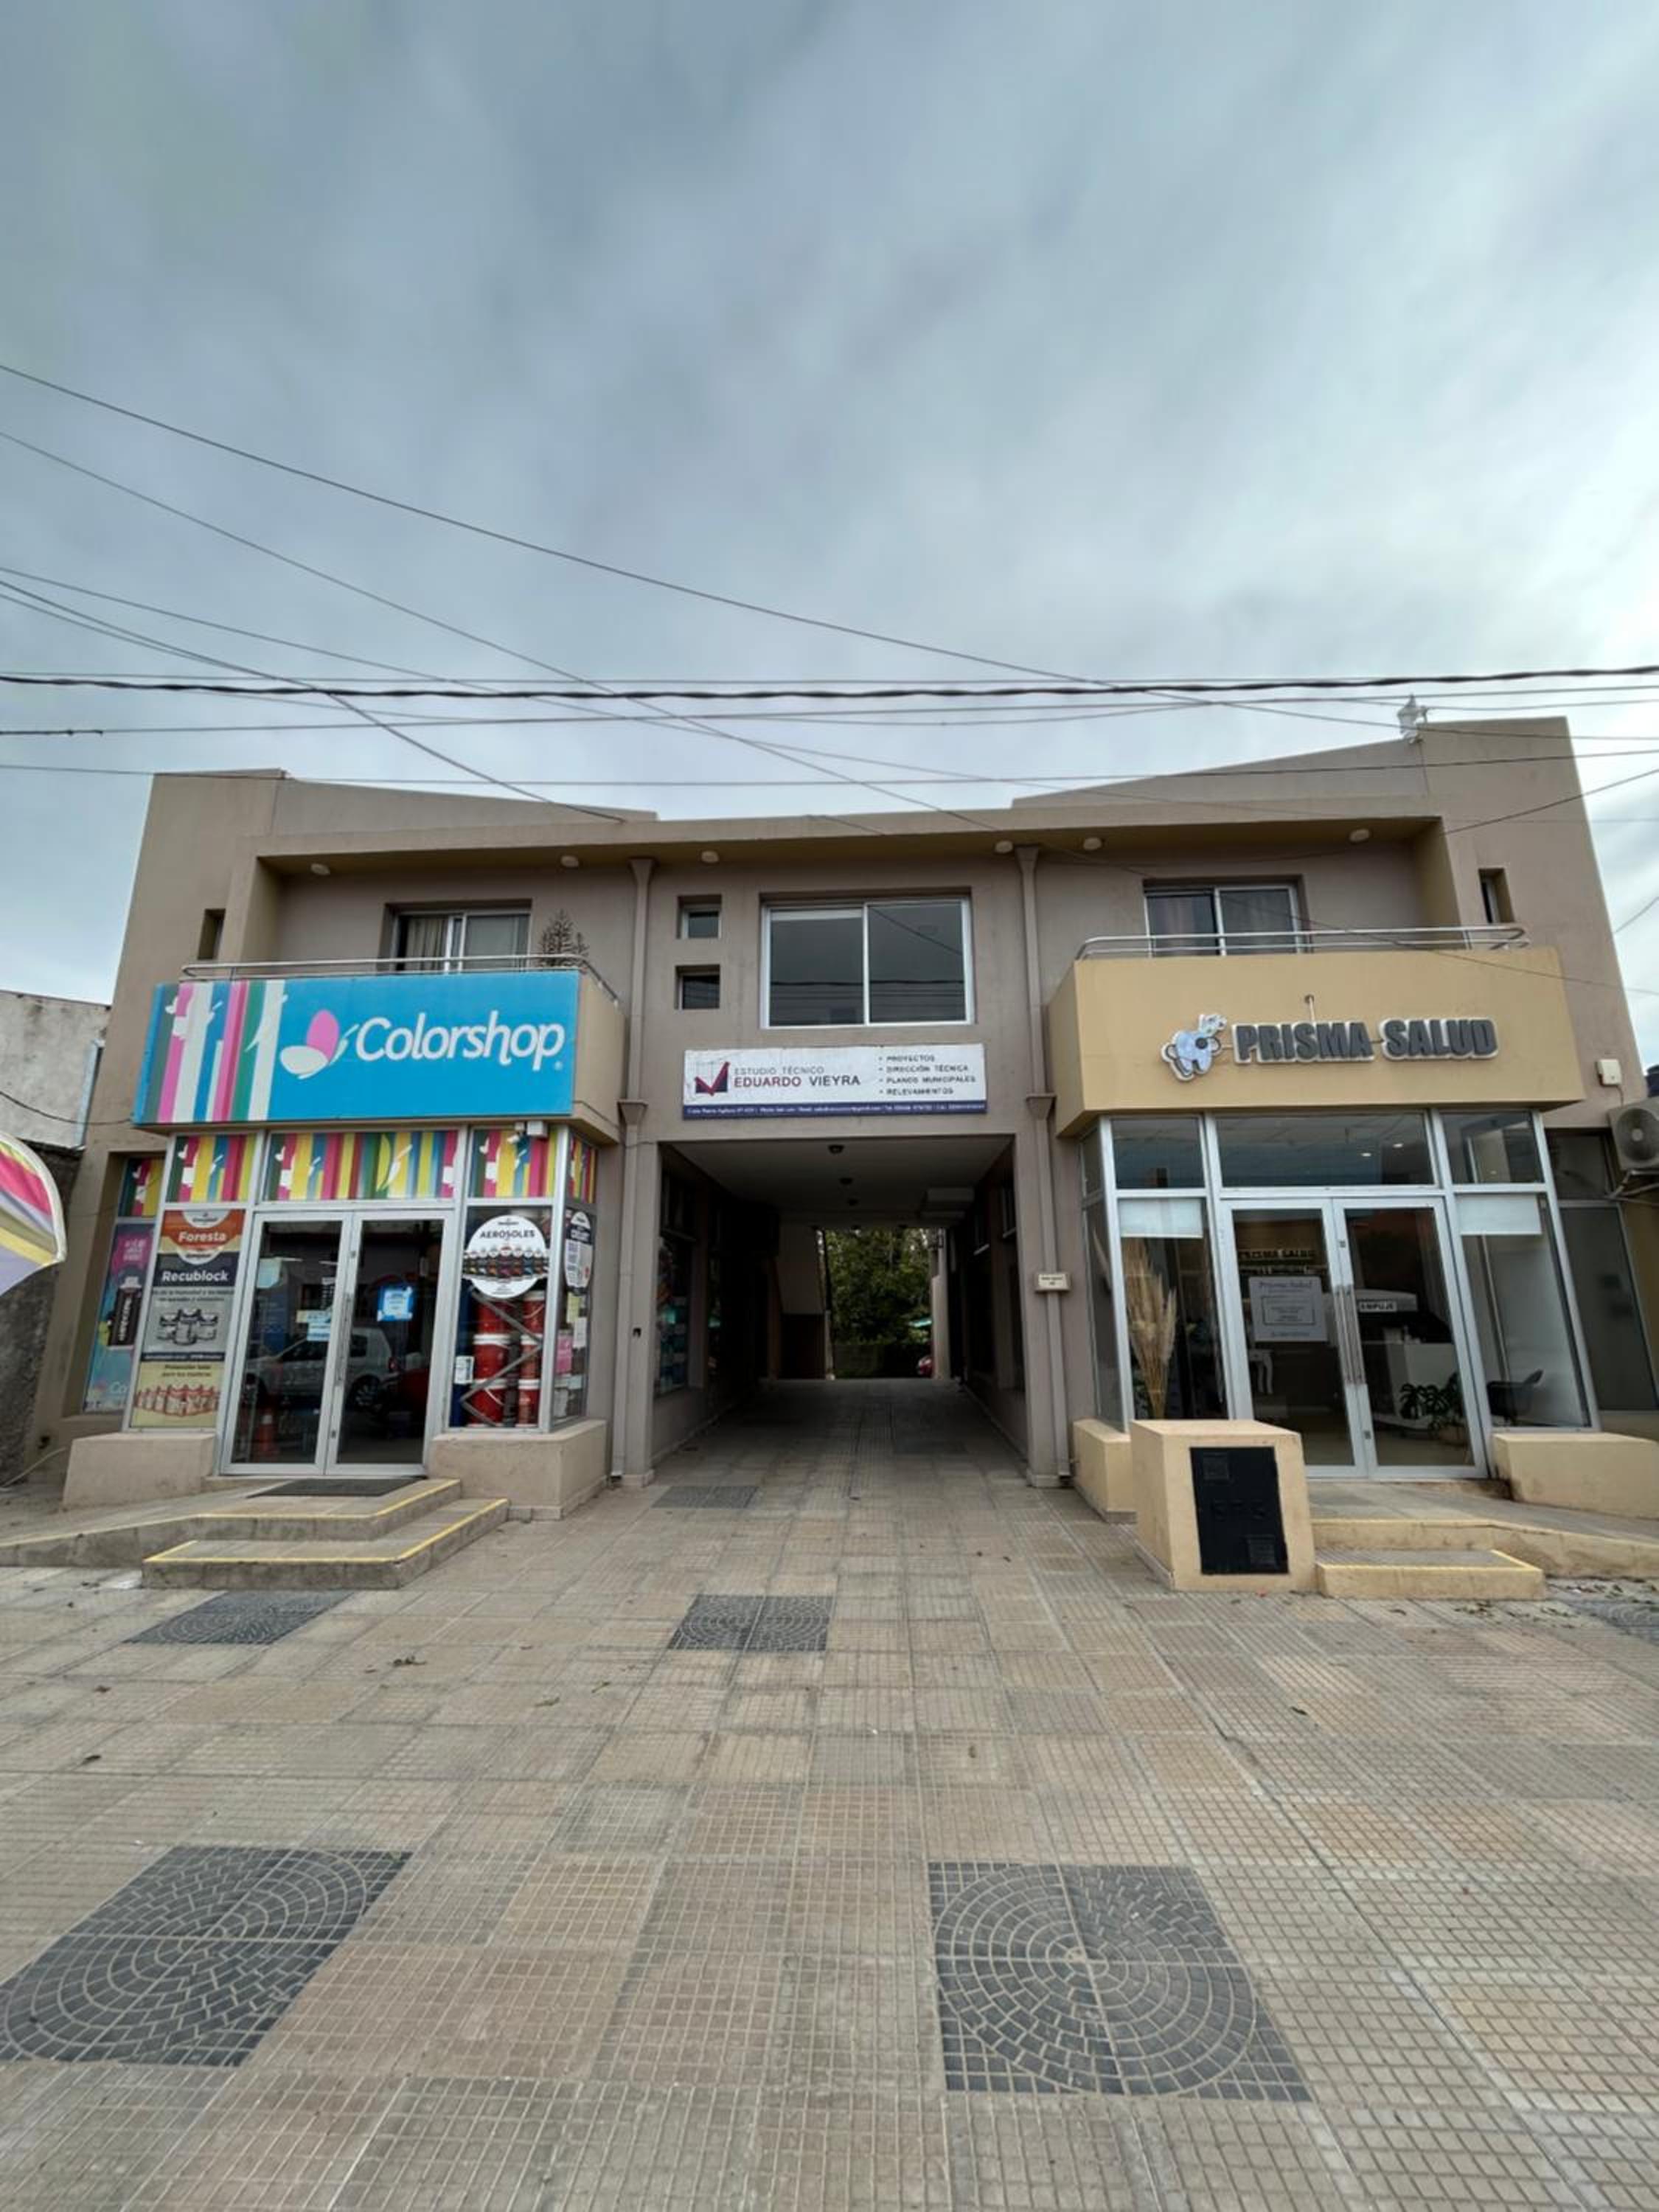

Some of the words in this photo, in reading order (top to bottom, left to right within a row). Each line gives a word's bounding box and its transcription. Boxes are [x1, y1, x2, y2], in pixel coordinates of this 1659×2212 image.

[355, 1010, 566, 1071] Colorshop
[1234, 1022, 1374, 1062] PRISMA
[1383, 1018, 1498, 1057] SALUD
[734, 1068, 777, 1076] ESTUDIO
[782, 1065, 824, 1074] TÉCNICO
[734, 1076, 802, 1088] EDUARDO
[809, 1075, 861, 1087] VIEYRA
[178, 1231, 227, 1243] Foresta
[480, 1229, 535, 1239] AEROSOLES
[161, 1270, 229, 1282] Recublock
